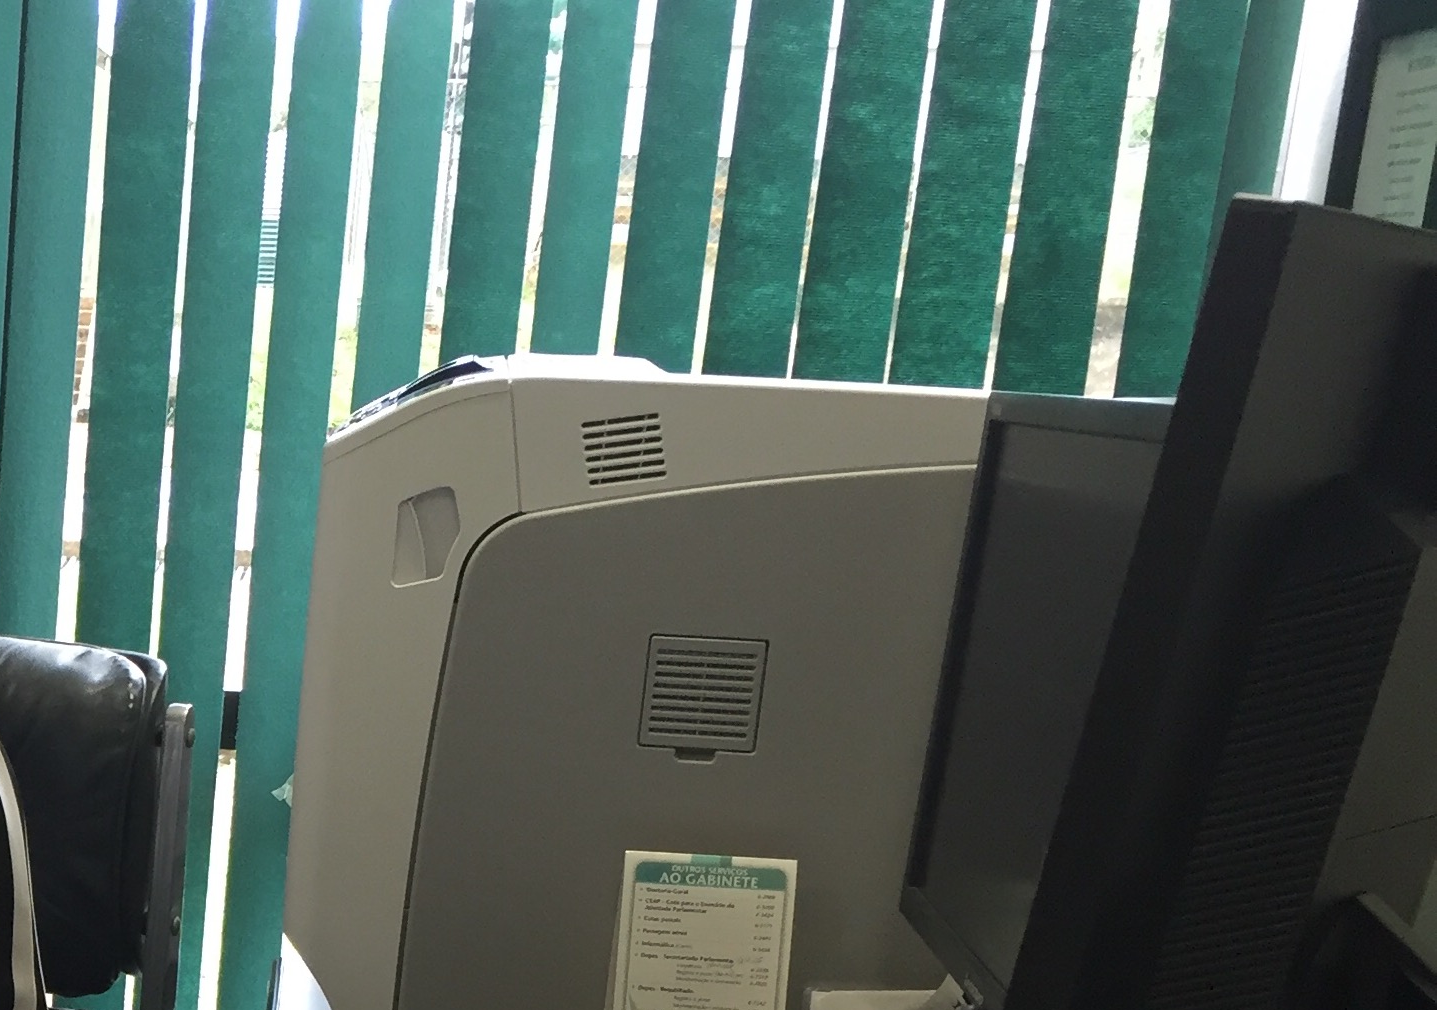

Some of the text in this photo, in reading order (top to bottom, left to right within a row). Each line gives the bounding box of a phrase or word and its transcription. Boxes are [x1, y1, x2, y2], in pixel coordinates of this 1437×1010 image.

[671, 865, 749, 877] OUTROS SERVIÇOS
[659, 872, 759, 889] AO GABINETE
